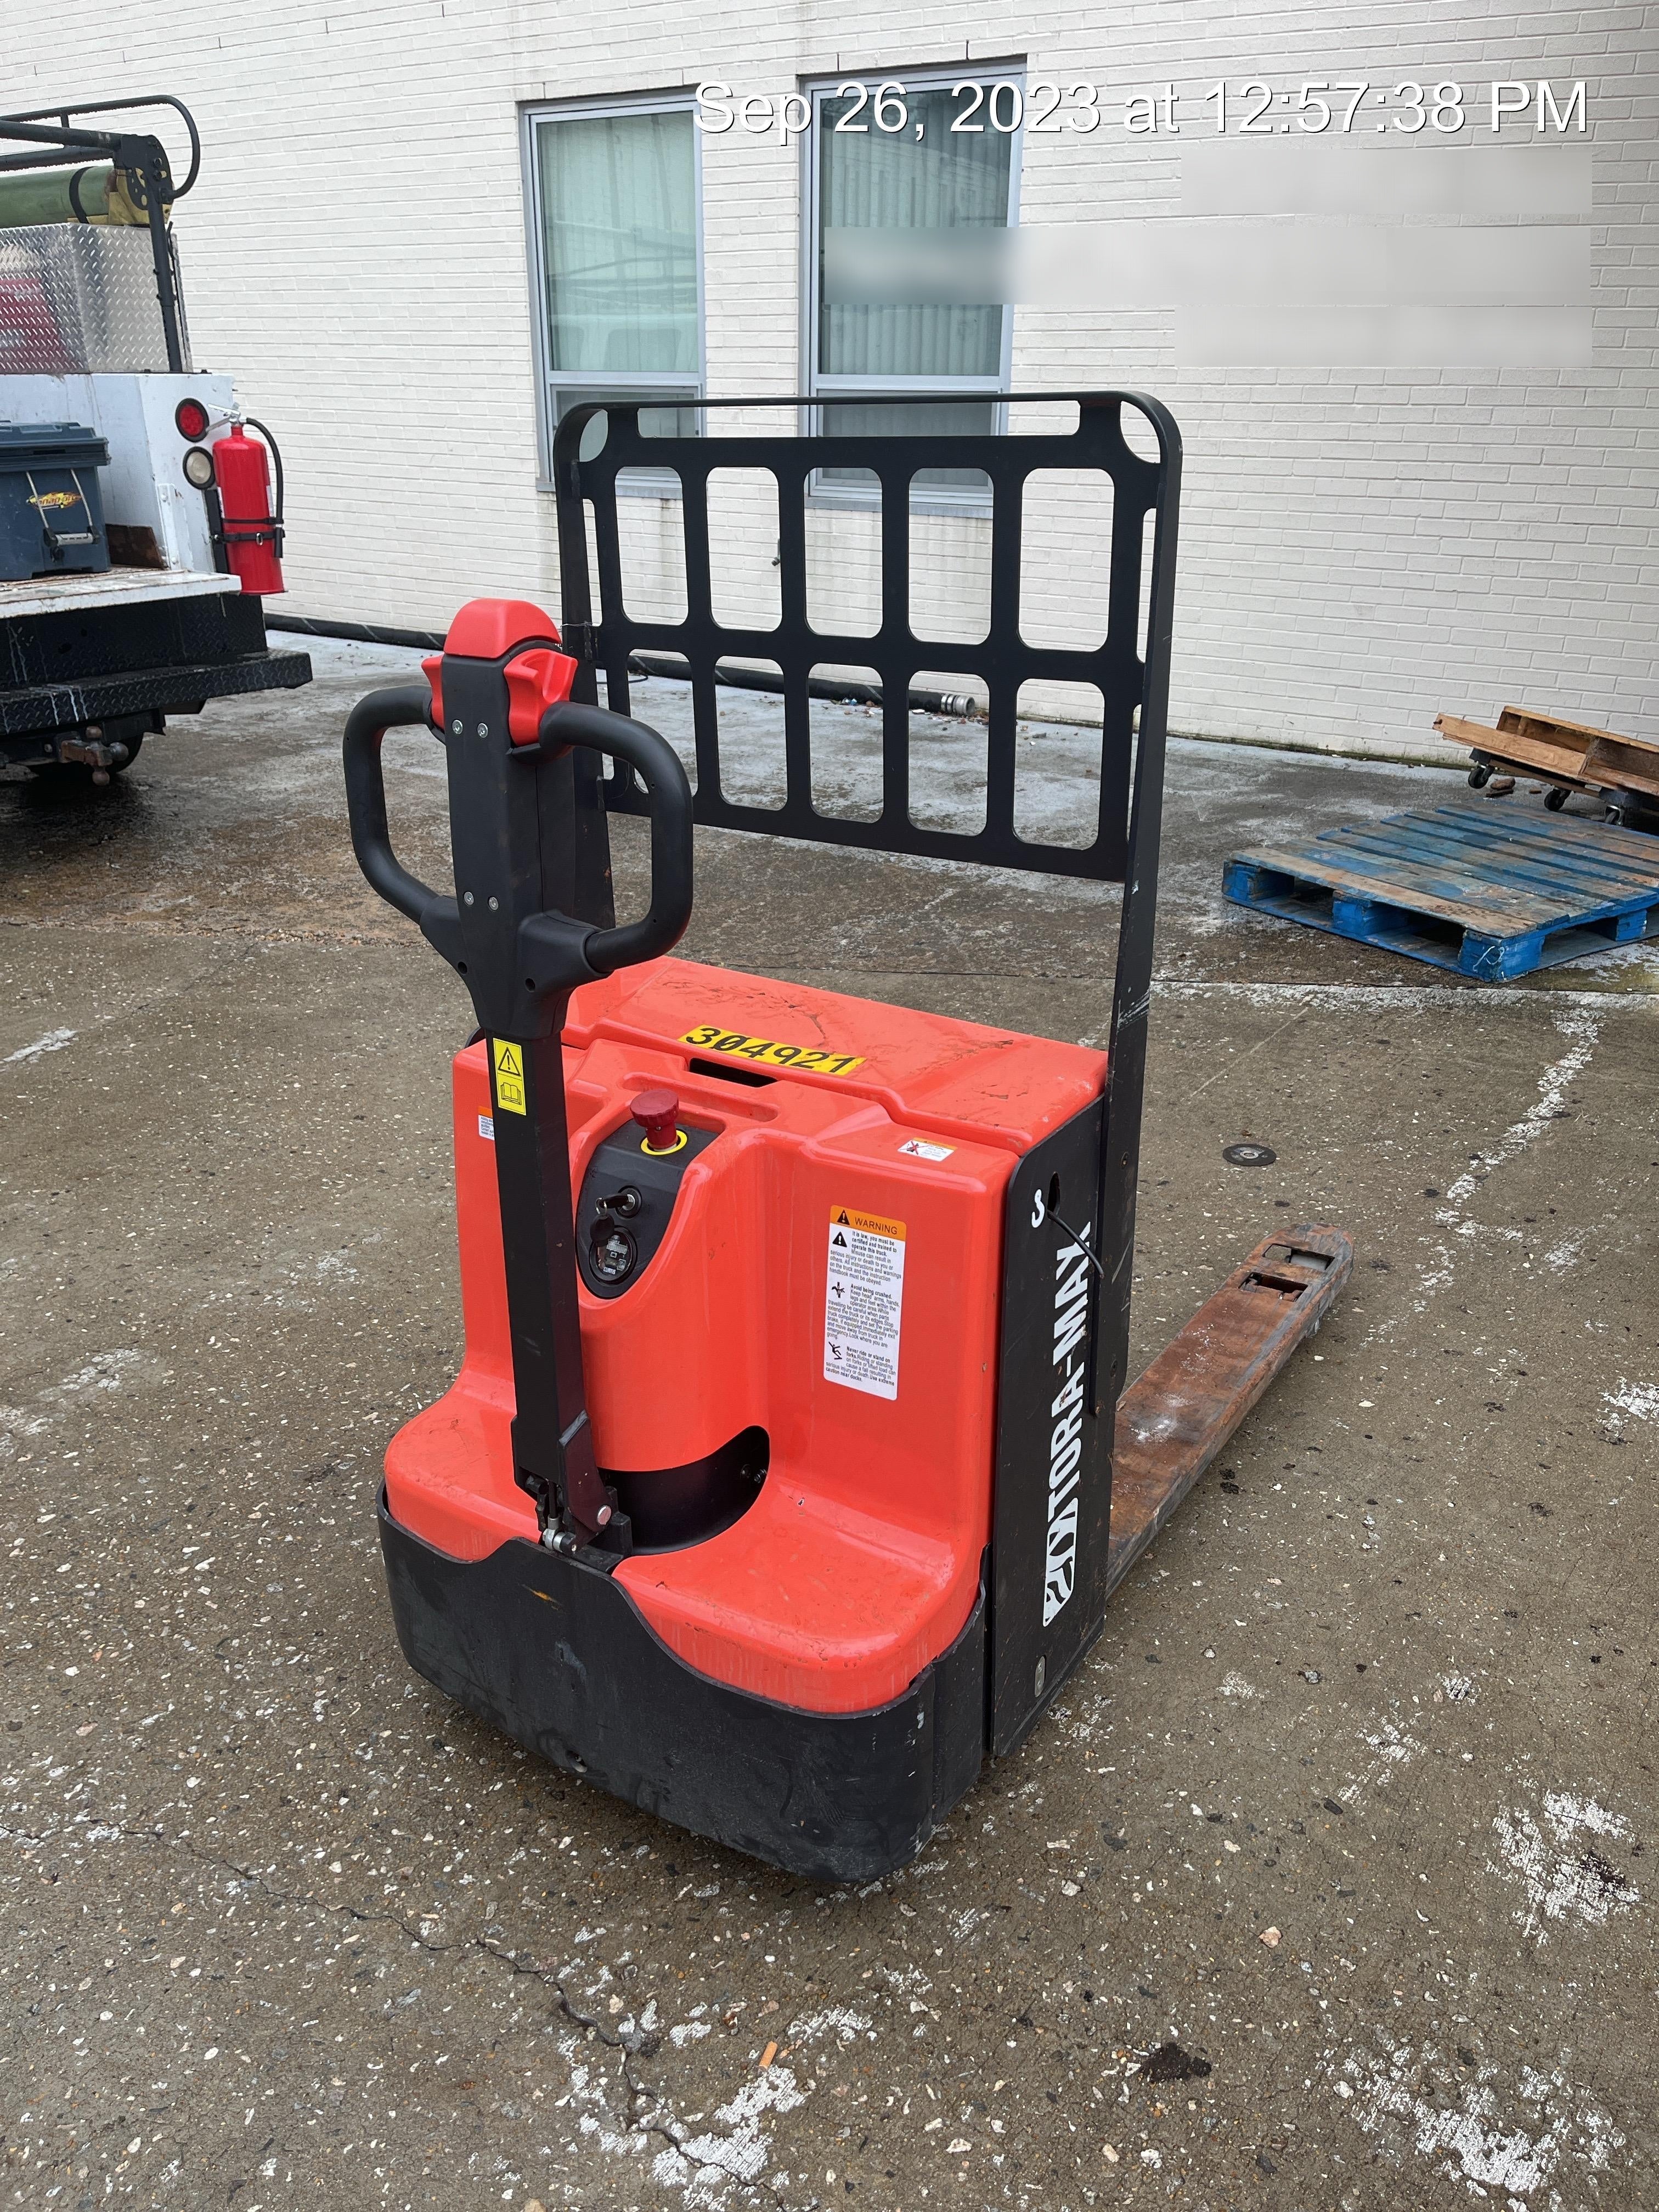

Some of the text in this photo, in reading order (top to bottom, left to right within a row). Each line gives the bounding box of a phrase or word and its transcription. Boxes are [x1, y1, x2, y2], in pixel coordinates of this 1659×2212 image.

[686, 1027, 856, 1073] 304921
[855, 1217, 898, 1235] WARNING
[1047, 1221, 1092, 1523] TORA-MAX
